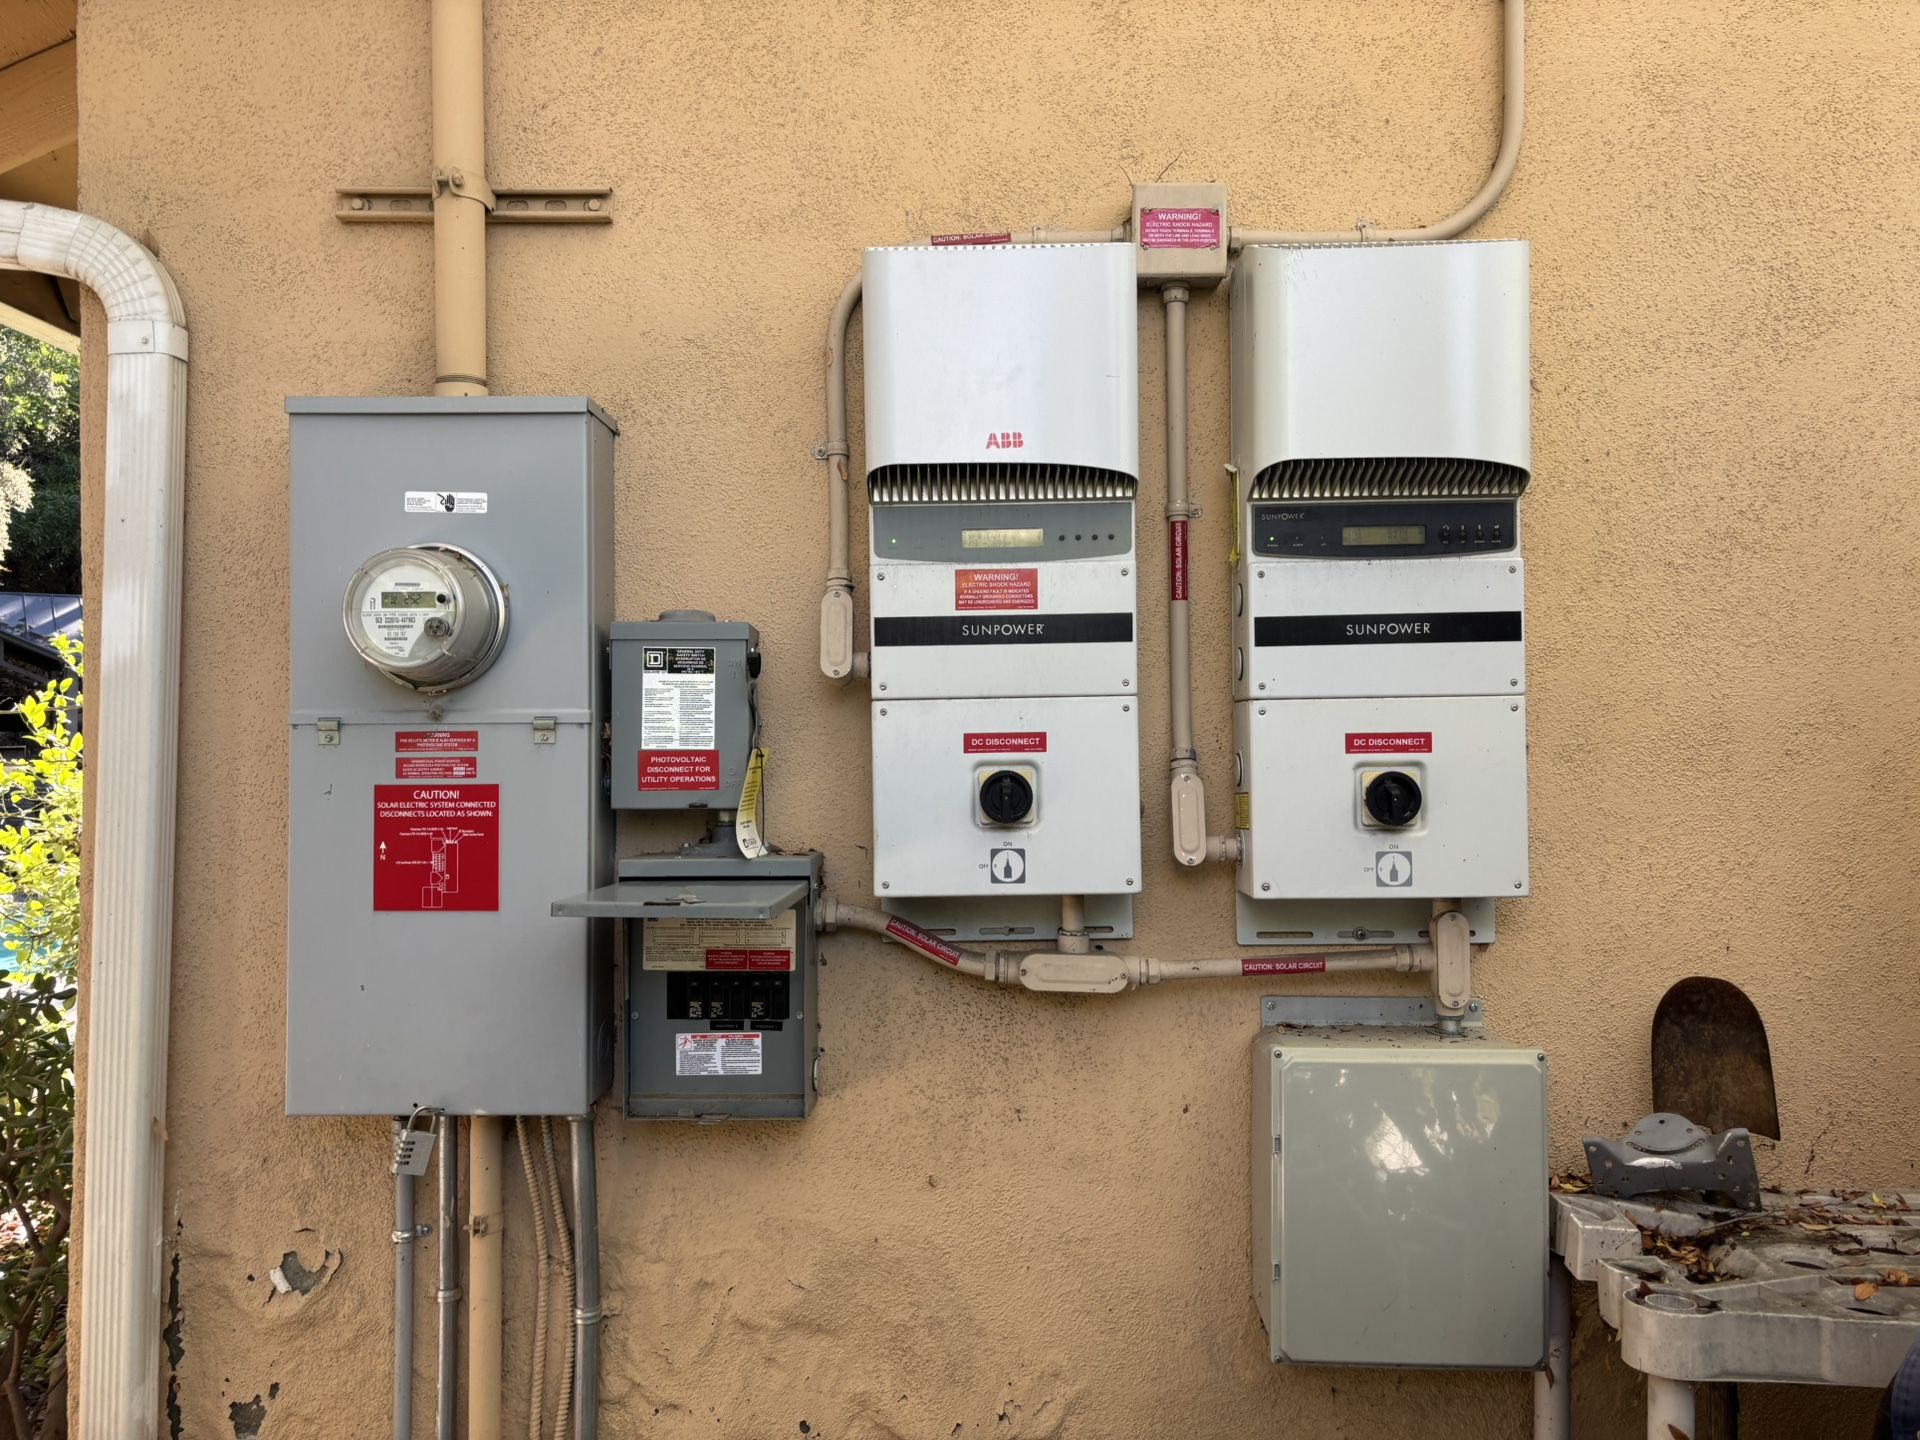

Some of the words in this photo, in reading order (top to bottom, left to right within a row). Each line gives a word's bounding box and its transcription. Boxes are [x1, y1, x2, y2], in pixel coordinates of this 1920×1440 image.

[933, 235, 961, 243] CAUTION:
[985, 432, 1024, 449] ABB
[974, 573, 1018, 581] WARNING!
[962, 624, 1043, 635] SUNPOWER
[1346, 623, 1430, 635] SUNPOWER
[413, 790, 459, 799] CAUTION!
[917, 933, 938, 947] SOLAR
[937, 943, 960, 958] CIRCUIT
